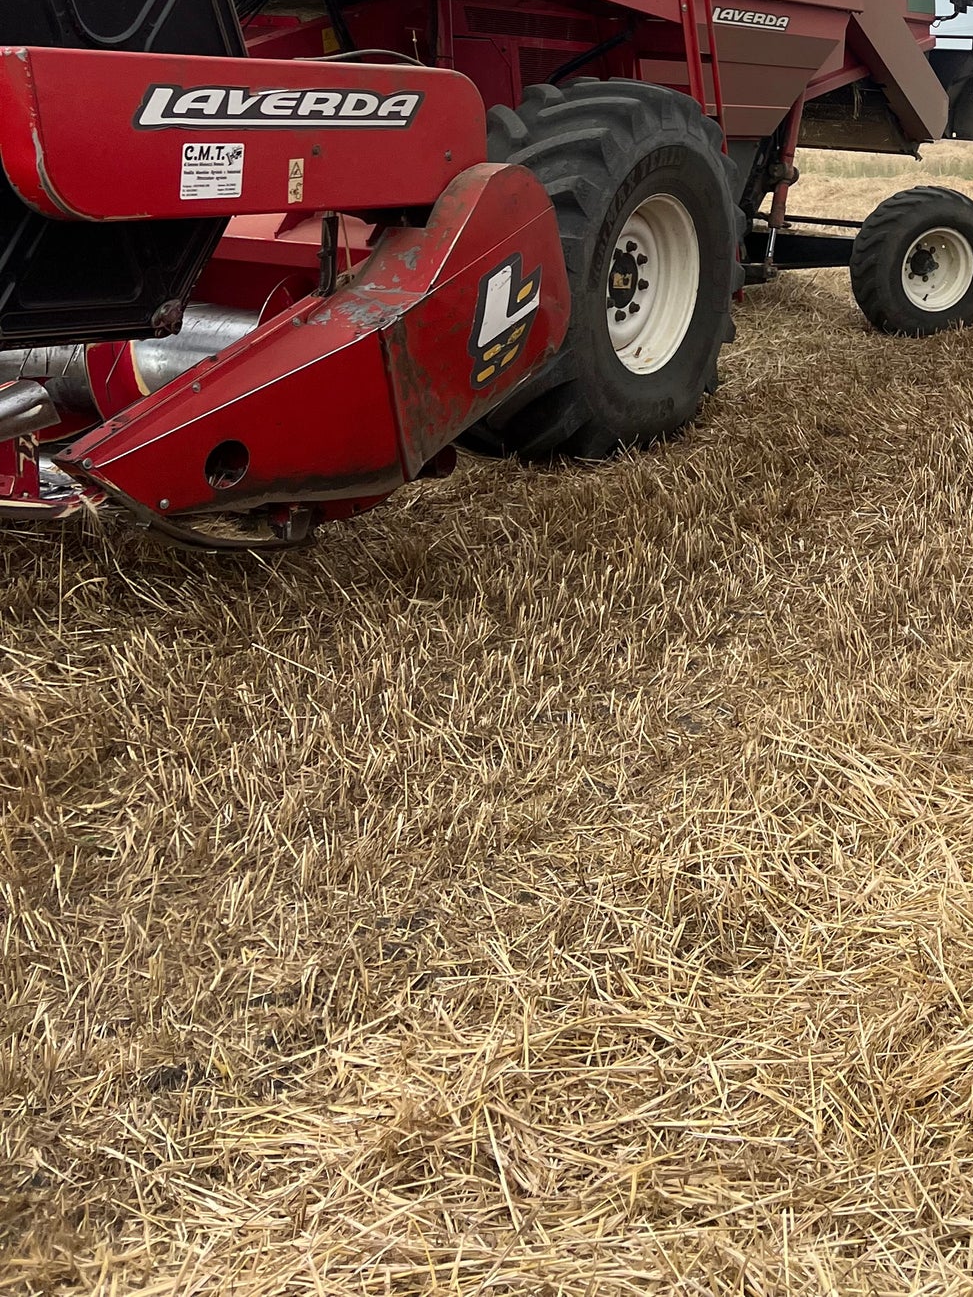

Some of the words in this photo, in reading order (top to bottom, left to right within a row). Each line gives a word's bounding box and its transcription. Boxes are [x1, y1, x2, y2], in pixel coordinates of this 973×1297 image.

[712, 7, 790, 31] LAVERDA
[139, 87, 420, 125] LAVERDA
[184, 145, 225, 161] C.M.T.
